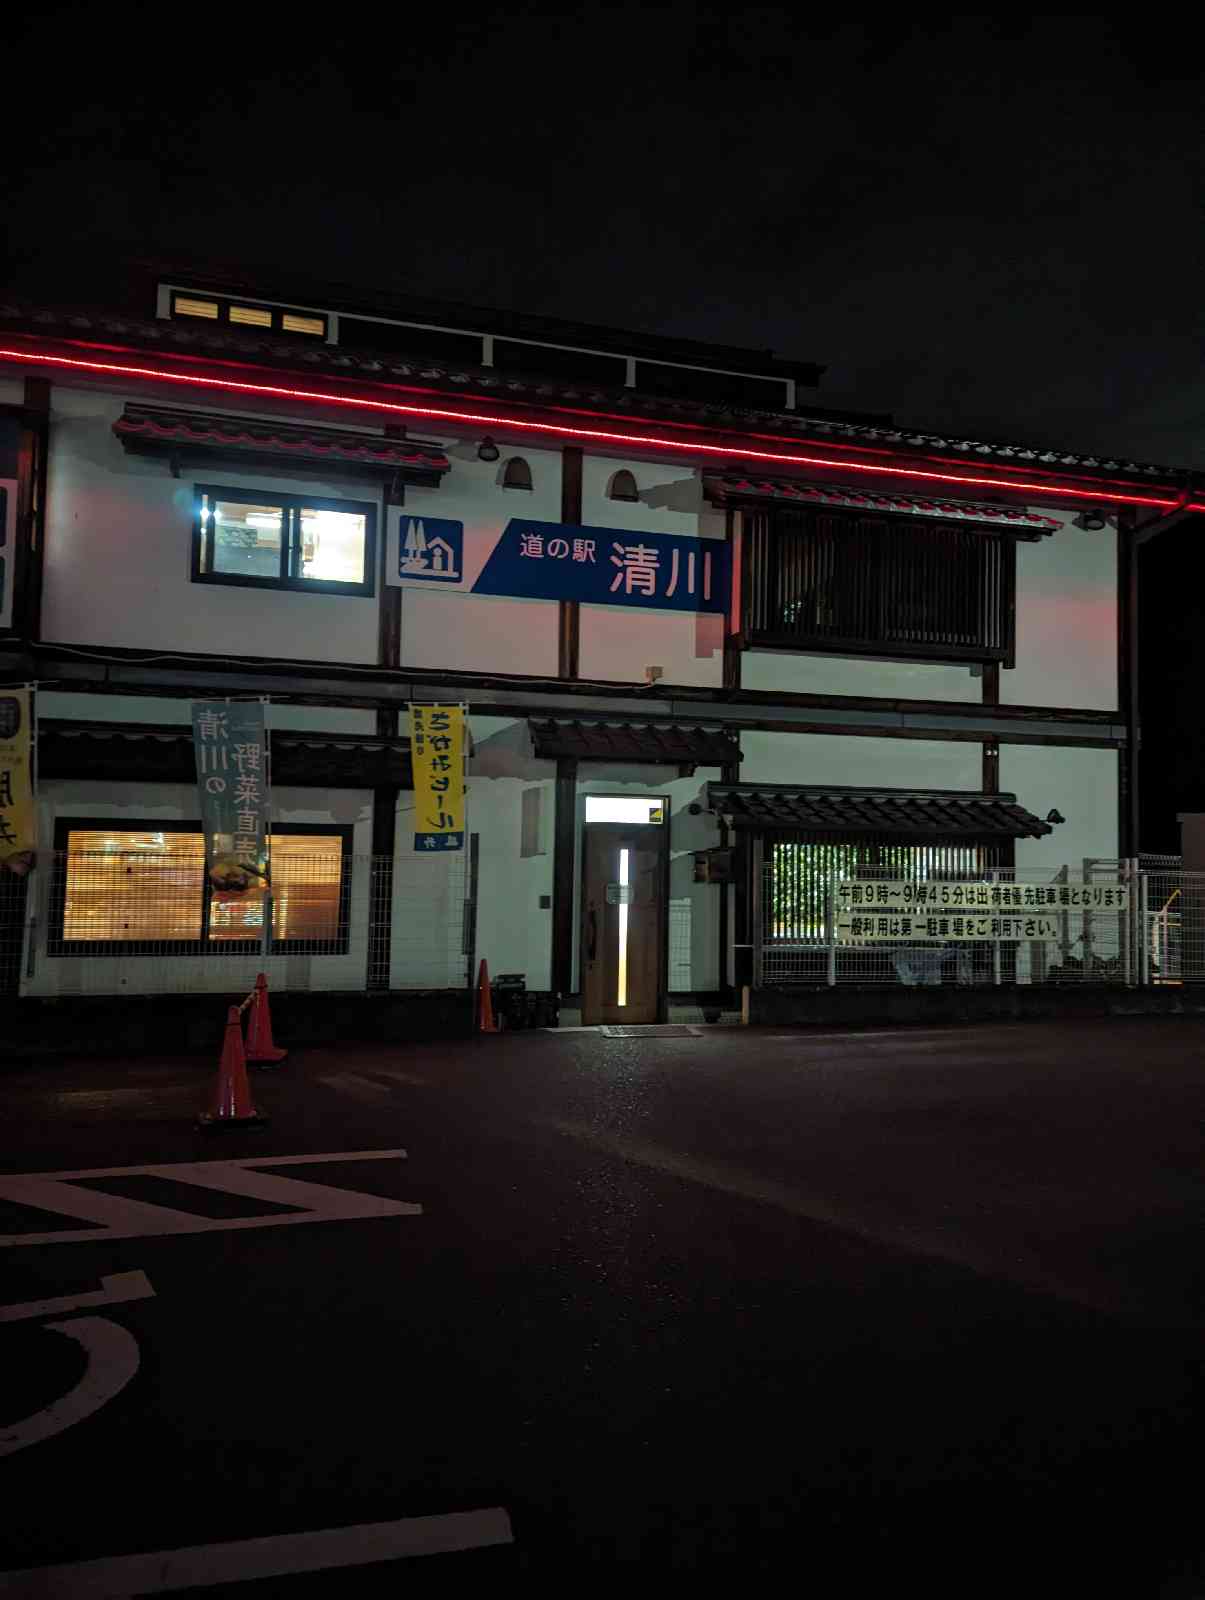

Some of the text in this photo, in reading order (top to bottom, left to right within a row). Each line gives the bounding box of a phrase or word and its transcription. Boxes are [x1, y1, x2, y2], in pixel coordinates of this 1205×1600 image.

[519, 532, 713, 601] 道の駅 清川
